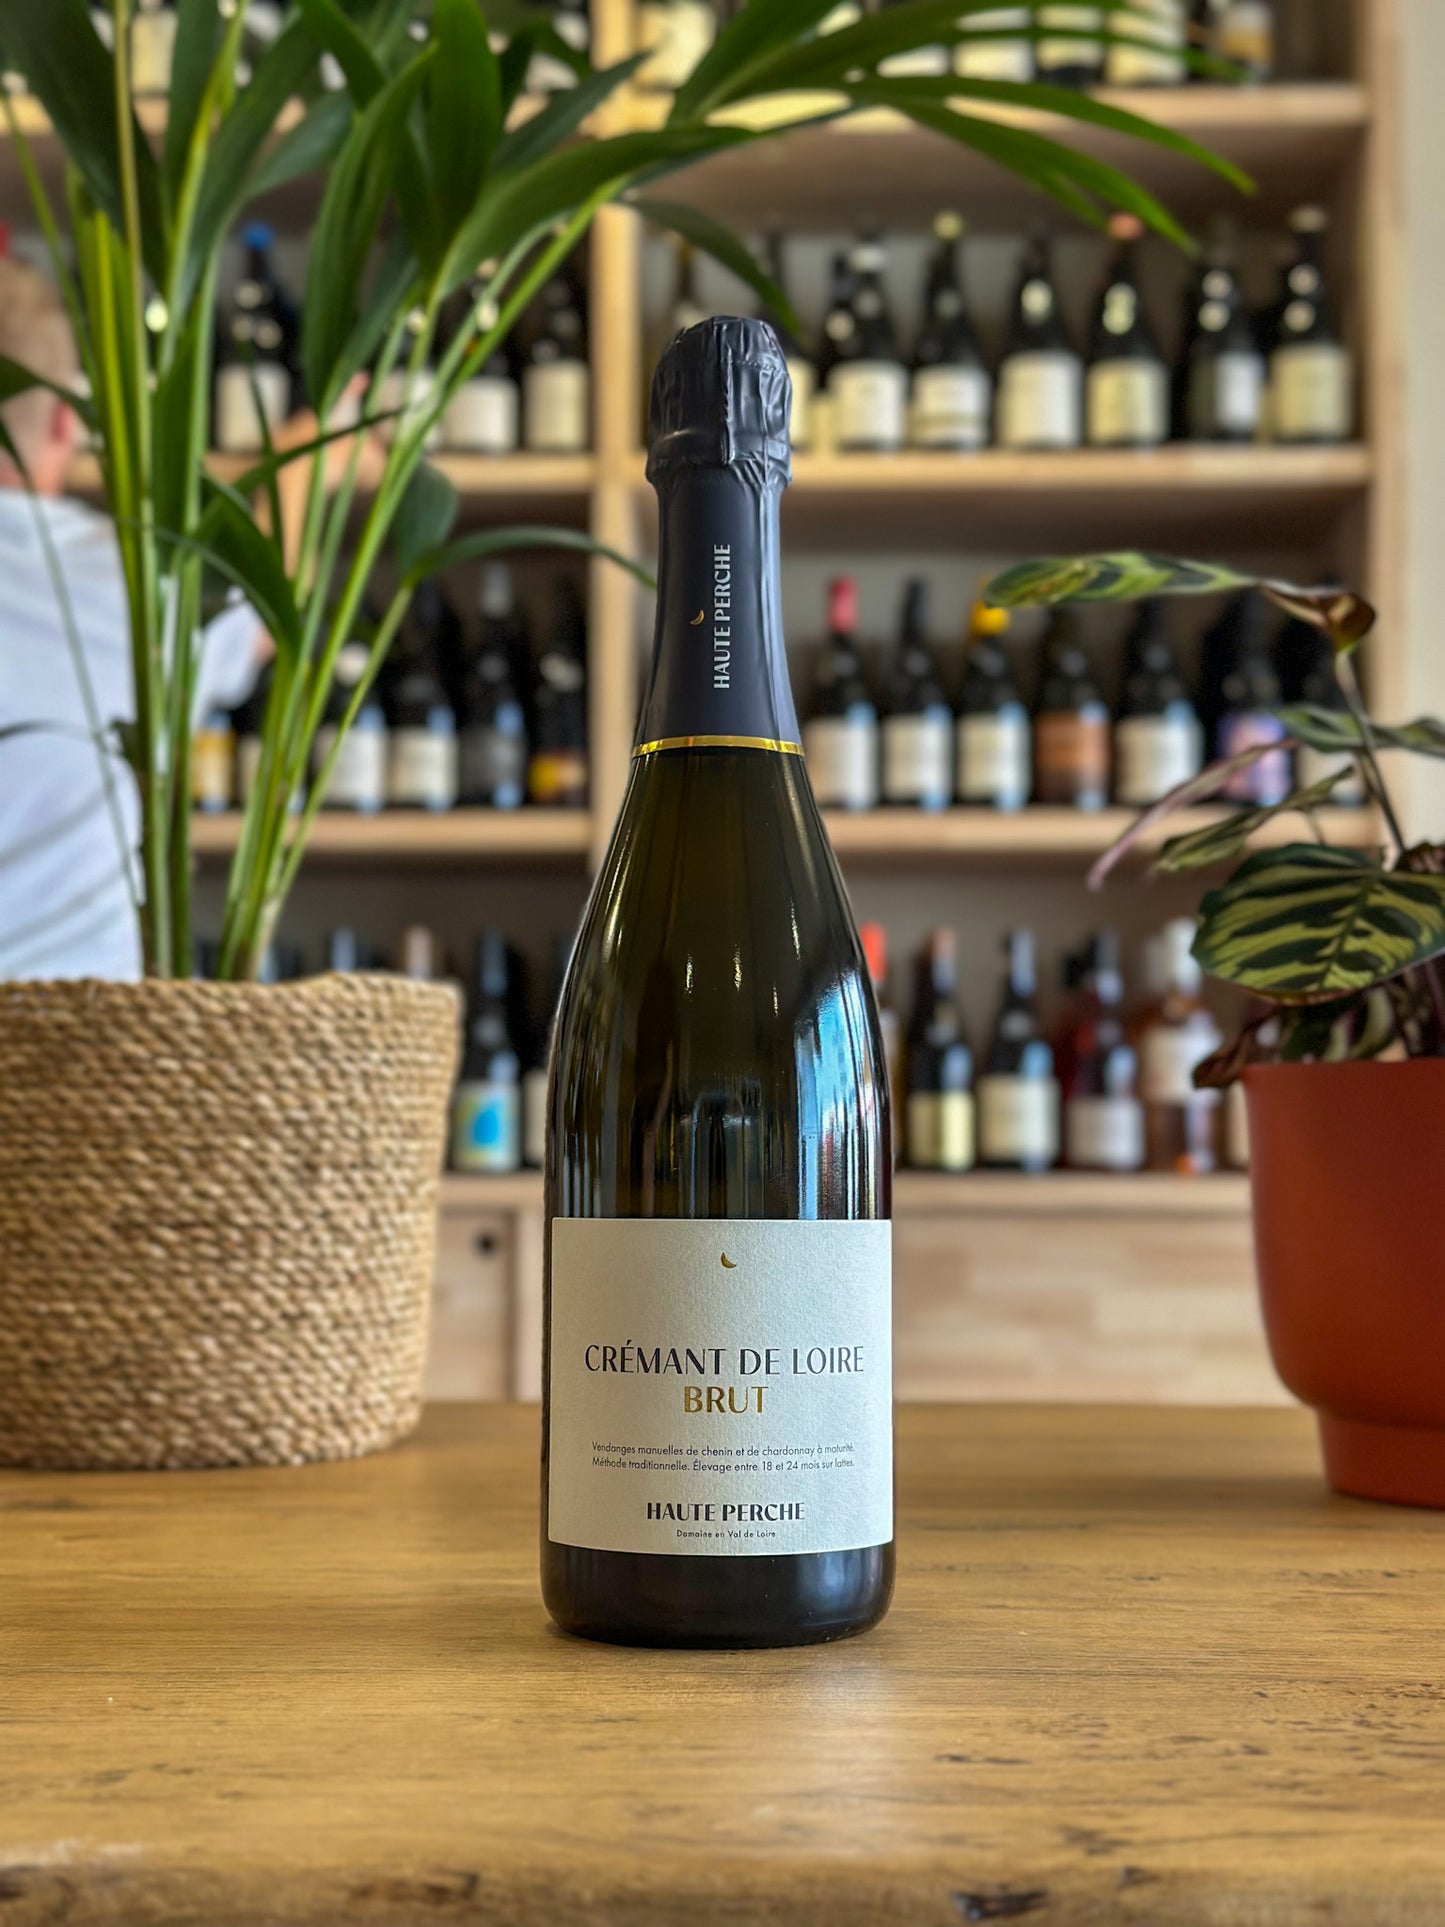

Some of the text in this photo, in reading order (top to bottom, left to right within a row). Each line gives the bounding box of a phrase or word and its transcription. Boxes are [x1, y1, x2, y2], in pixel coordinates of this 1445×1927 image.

[714, 544, 731, 689] HAUTE PERCHE
[584, 1339, 864, 1375] CRÉMANT DE LOIRE
[684, 1386, 769, 1414] BRUT
[592, 1441, 855, 1457] Vendanges manuelles de chenin et de chardonnay à maturité.
[592, 1457, 627, 1468] Méthode
[628, 1459, 690, 1471] traditionnelle.
[693, 1458, 732, 1474] Élevage
[734, 1462, 758, 1471] entre
[763, 1461, 773, 1471] 18
[775, 1462, 784, 1471] et
[786, 1460, 798, 1471] 24
[801, 1461, 820, 1470] mois
[822, 1461, 833, 1469] sur
[647, 1502, 806, 1522] HAUTE PERCHE
[676, 1530, 712, 1538] Domaine
[728, 1530, 741, 1538] Val
[744, 1530, 754, 1538] de
[756, 1530, 776, 1538] Loire
